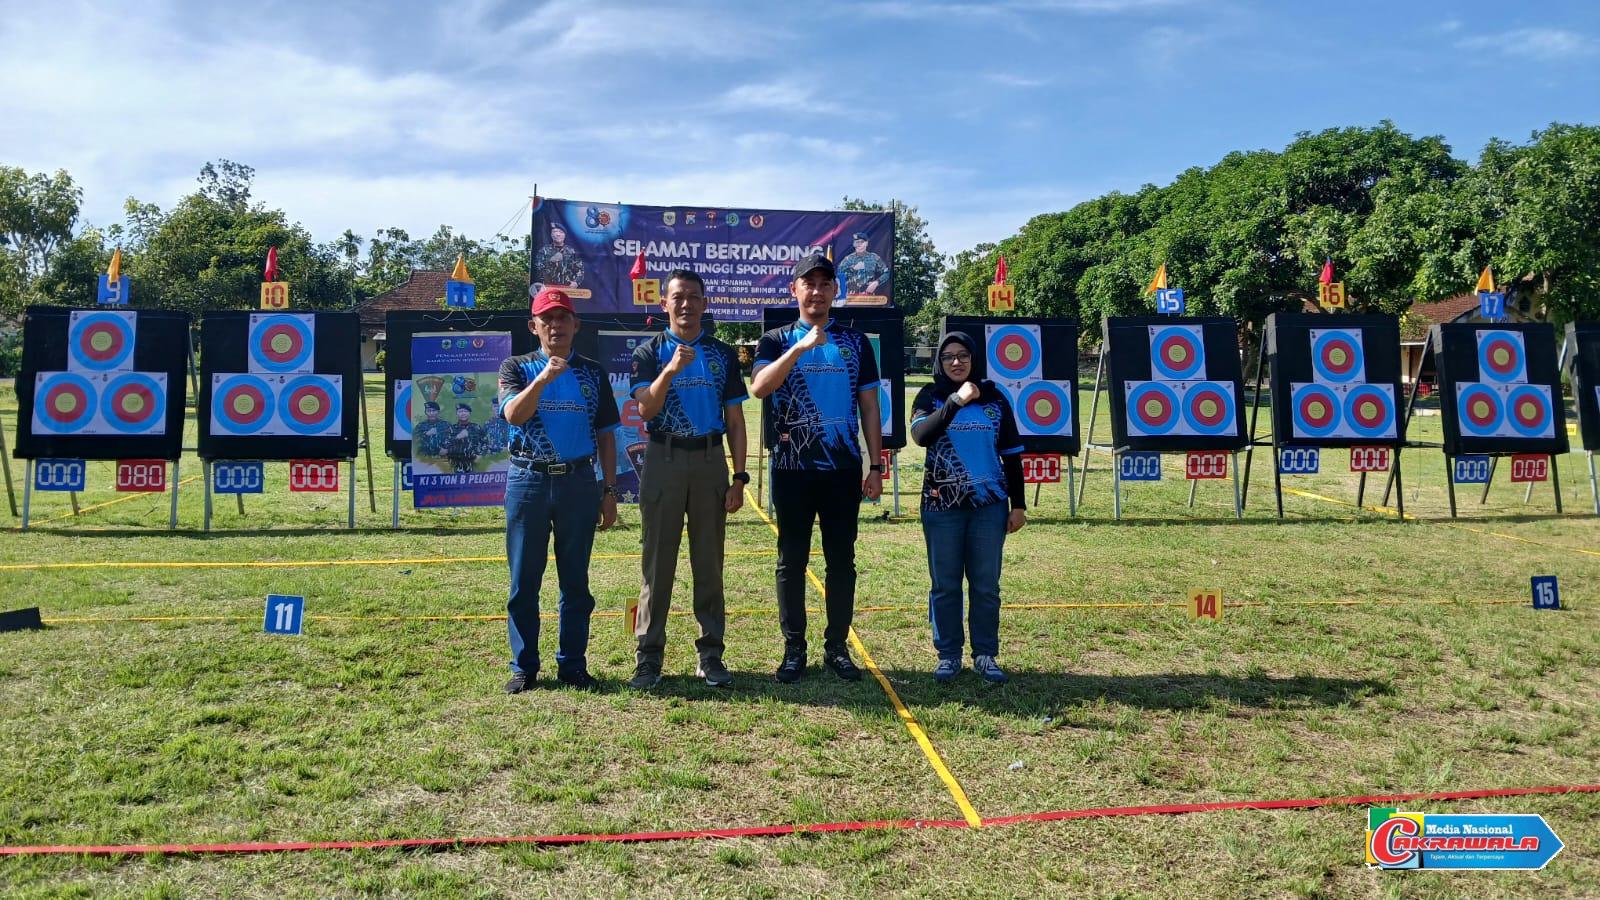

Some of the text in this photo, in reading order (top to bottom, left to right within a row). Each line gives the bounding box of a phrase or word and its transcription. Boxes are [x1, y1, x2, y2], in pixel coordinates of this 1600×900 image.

[613, 238, 700, 258] SELAMAT
[693, 263, 734, 274] TINGGI
[721, 279, 752, 287] PANAHAN
[265, 284, 285, 308] 10
[711, 297, 790, 305] UNTUK MASYARAKAT
[991, 290, 1011, 308] 14
[1160, 291, 1180, 312] 15
[1324, 284, 1341, 306] 16
[1484, 295, 1500, 315] 17
[1021, 457, 1060, 480] 000
[1121, 455, 1160, 477] 000
[1188, 454, 1227, 476] 000
[1281, 449, 1319, 472] 000
[1352, 448, 1389, 470] 000
[1513, 459, 1547, 479] 000
[38, 462, 82, 486] 000
[118, 464, 163, 487] 080
[216, 466, 260, 488] 000
[292, 463, 337, 488] 000
[431, 476, 437, 485] 3
[439, 475, 457, 485] YON
[460, 475, 466, 484] B
[1456, 460, 1489, 482] 000
[1535, 582, 1554, 606] 15
[275, 602, 294, 631] 11
[1194, 594, 1217, 619] 14
